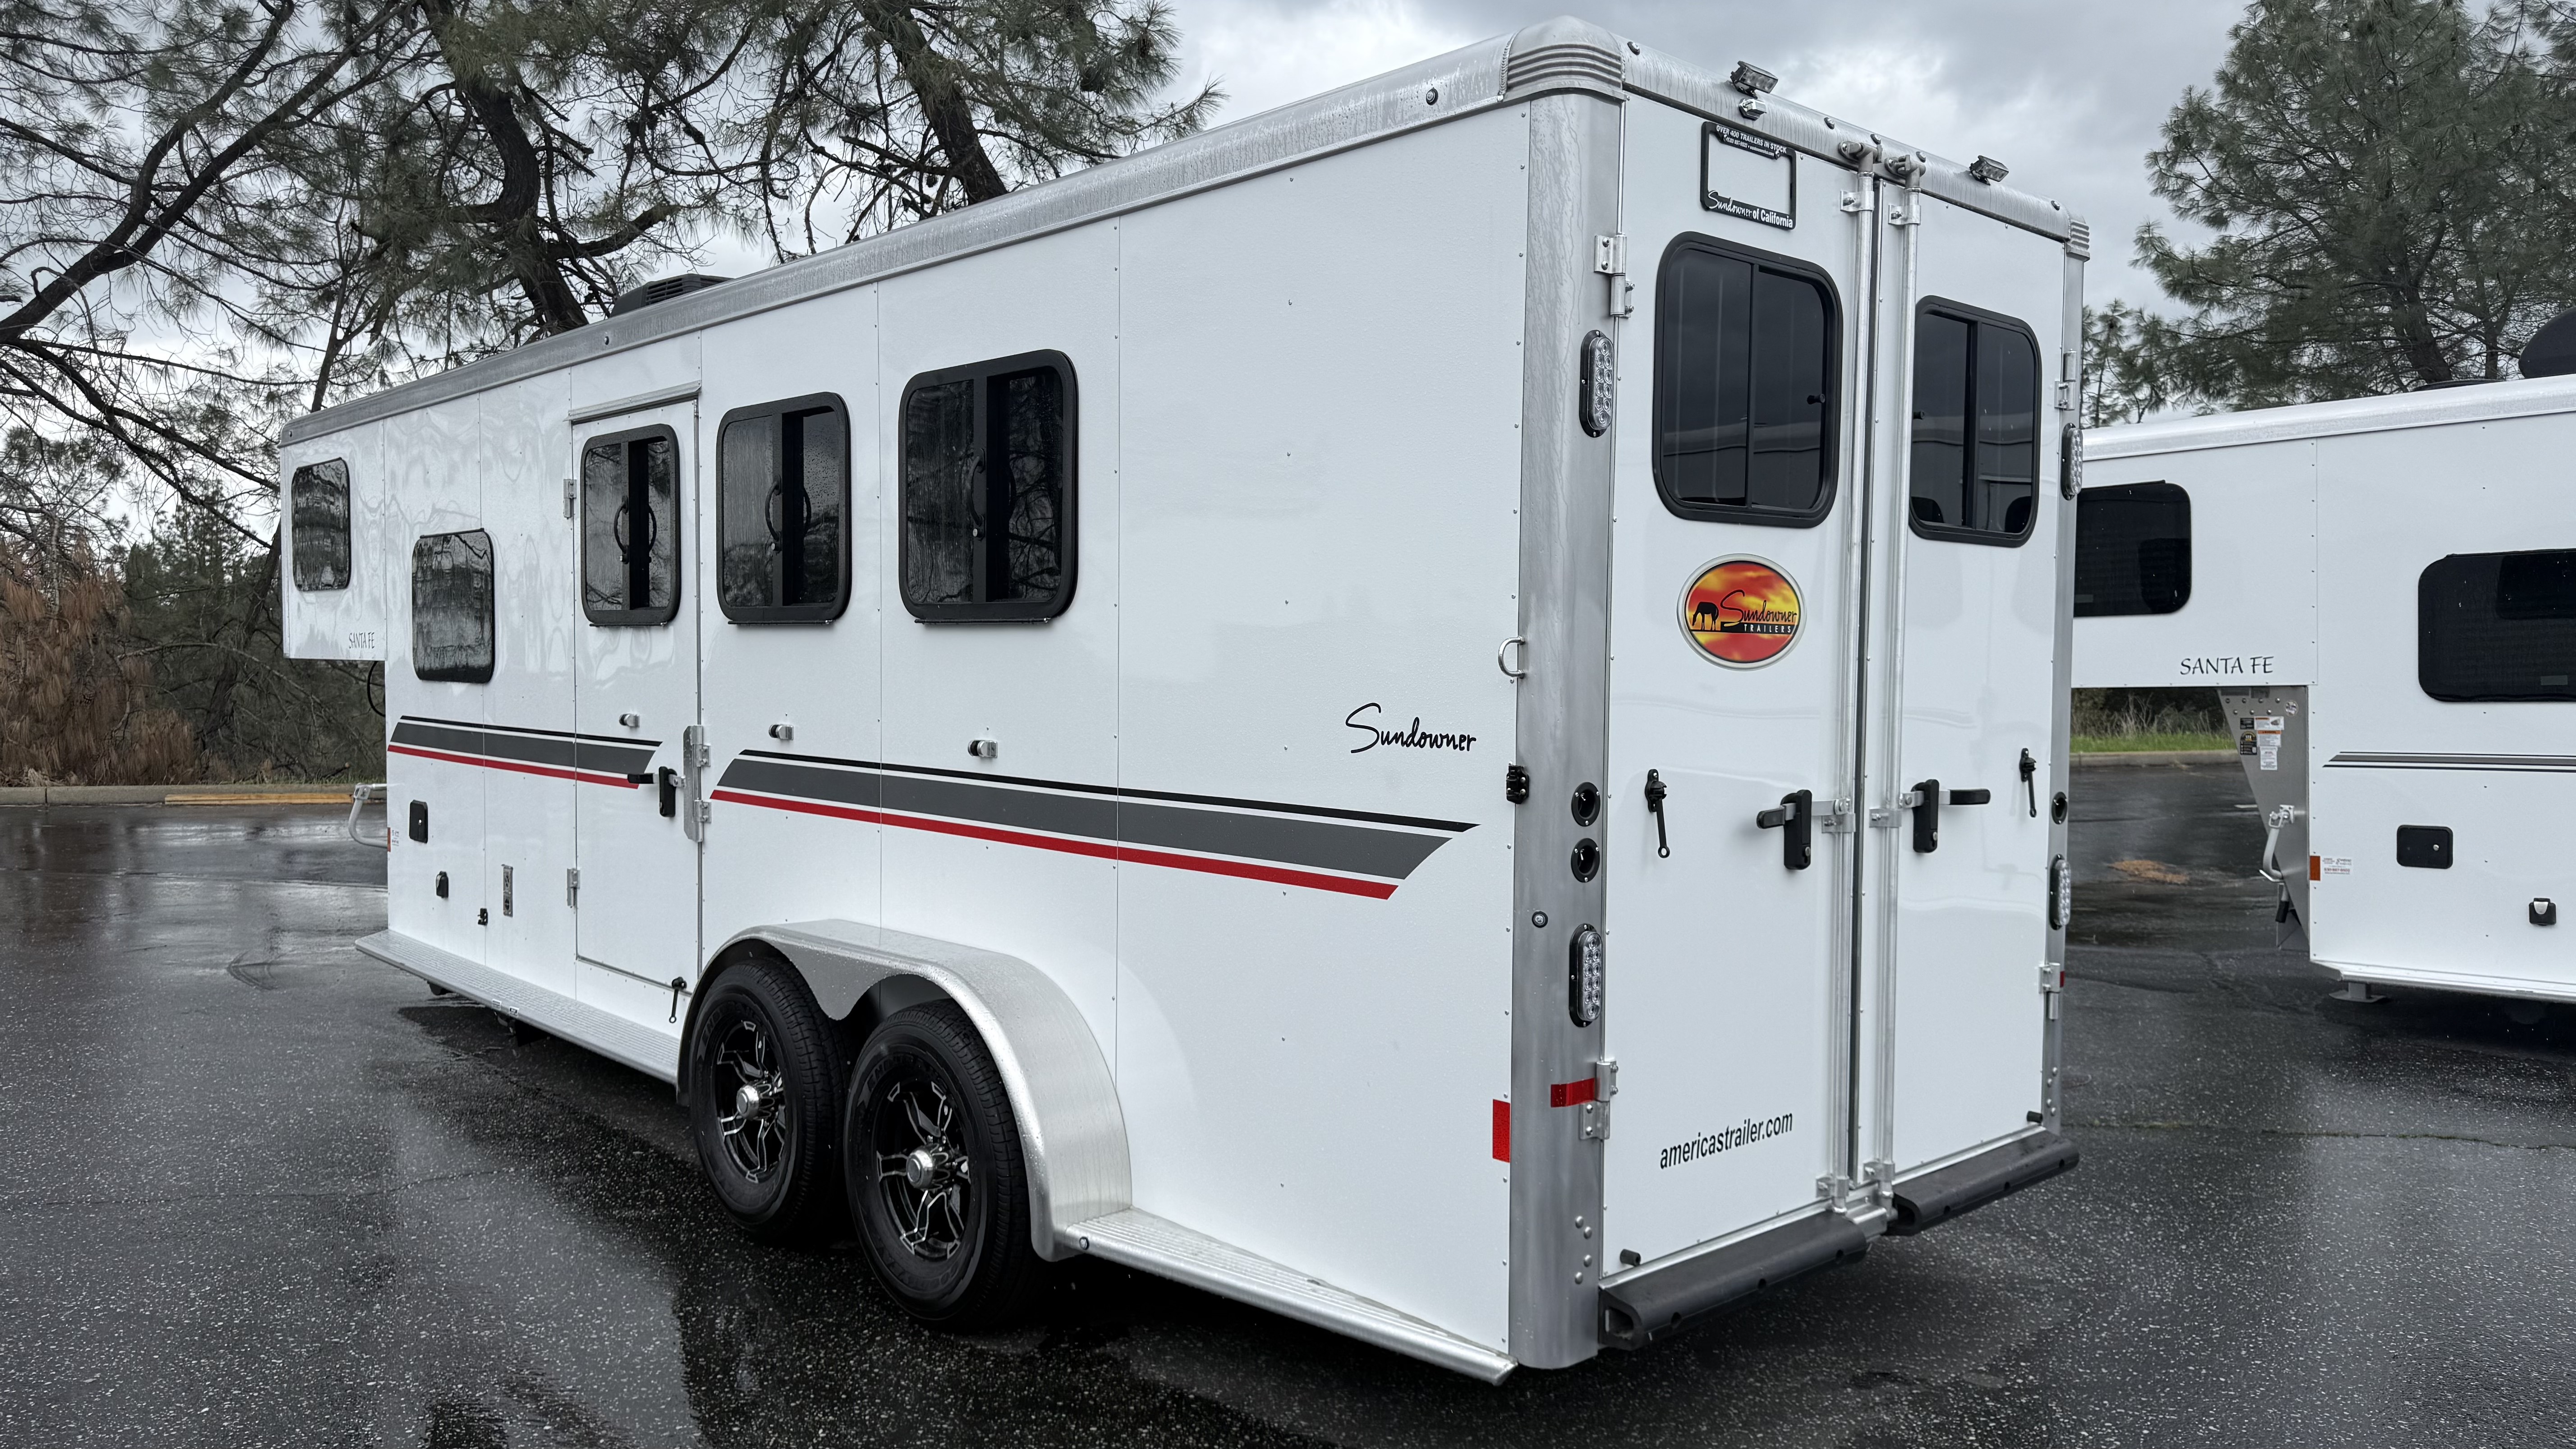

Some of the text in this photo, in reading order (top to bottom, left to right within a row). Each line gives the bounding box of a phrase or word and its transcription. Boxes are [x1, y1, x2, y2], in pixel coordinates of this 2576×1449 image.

[1716, 125, 1730, 135] OVER
[1730, 130, 1739, 138] 400
[1740, 133, 1763, 146] TRAILERS
[1770, 143, 1787, 154] STOCK
[1708, 190, 1793, 228] Sundowner of California
[1720, 589, 1797, 627] Sundowner
[349, 632, 375, 649] SANTA FE
[1743, 624, 1791, 633] TRAILERS
[2180, 656, 2274, 675] SANTA FE
[1345, 702, 1477, 754] Sundowner
[1660, 1113, 1793, 1169] americastrailer.com
